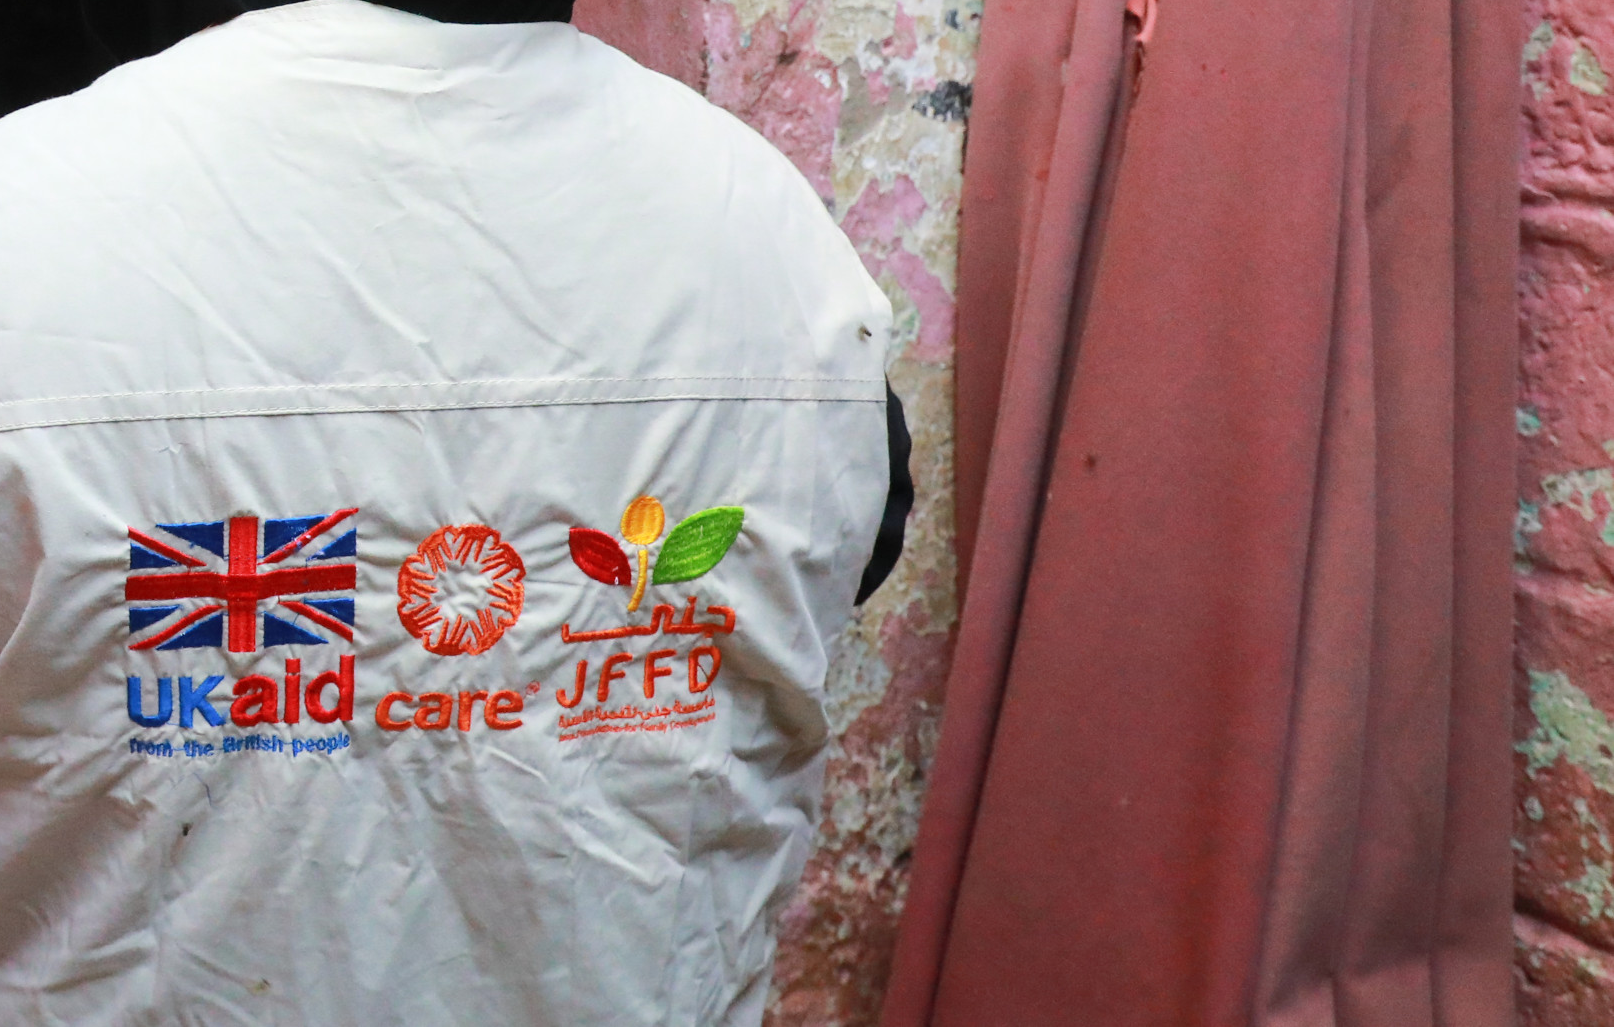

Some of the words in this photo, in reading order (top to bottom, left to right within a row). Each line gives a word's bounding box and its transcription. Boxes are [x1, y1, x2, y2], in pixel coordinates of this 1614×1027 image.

[555, 645, 722, 709] JFFD
[129, 737, 174, 758] from
[183, 738, 214, 758] the
[222, 732, 284, 754] British
[291, 731, 351, 758] people
